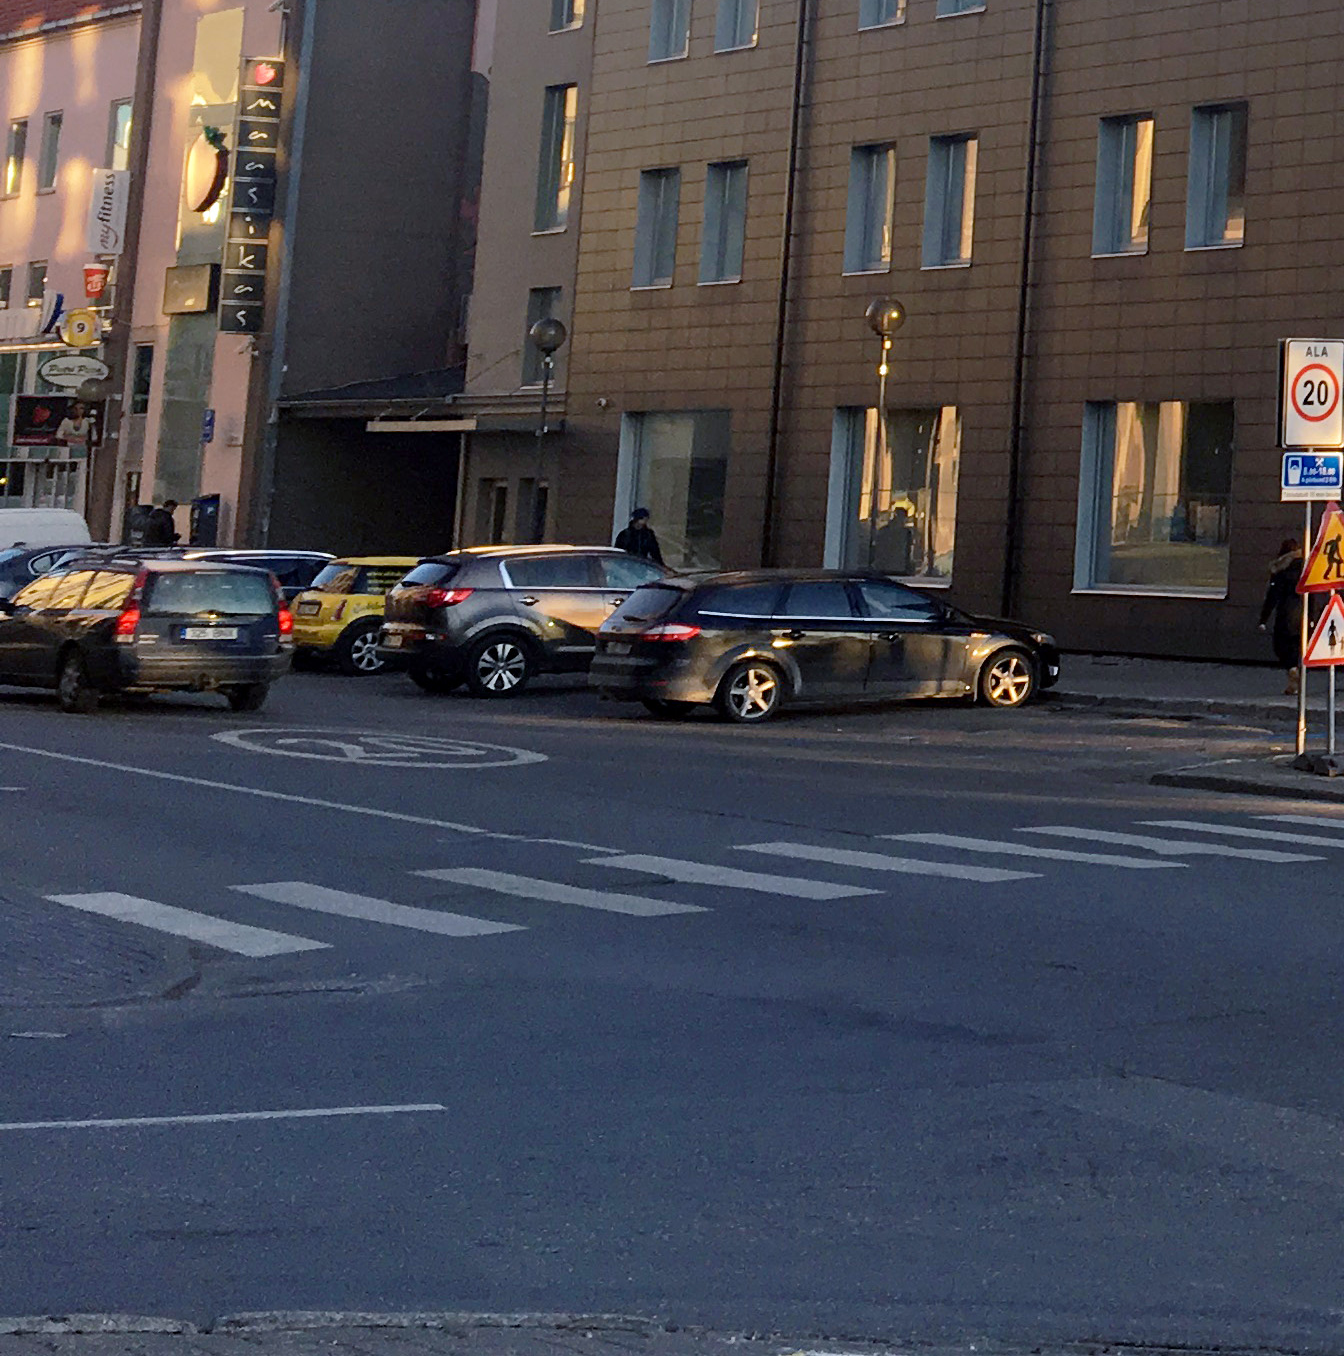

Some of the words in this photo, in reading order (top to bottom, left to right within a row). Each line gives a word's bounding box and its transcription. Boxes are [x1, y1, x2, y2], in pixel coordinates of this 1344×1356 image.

[97, 172, 118, 250] myfitness
[76, 322, 86, 333] 9
[1305, 346, 1329, 358] ALA
[1302, 379, 1329, 406] 20
